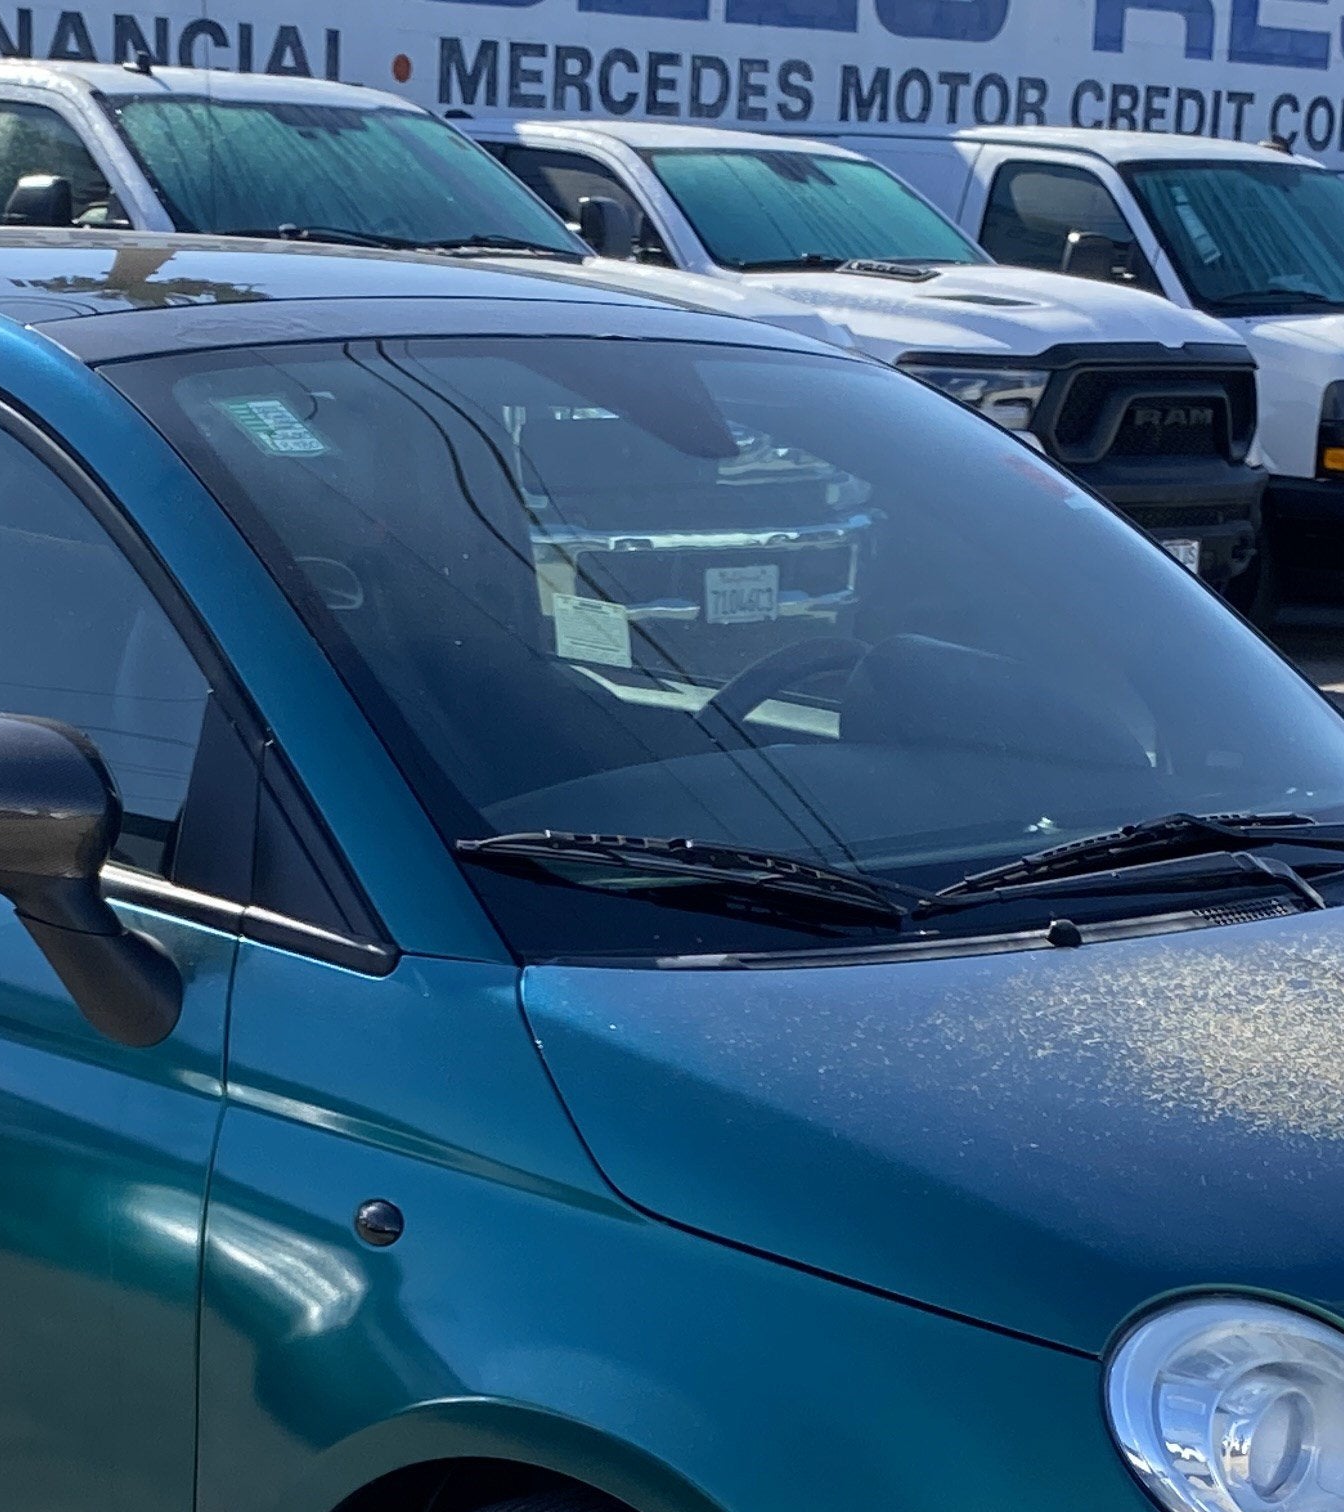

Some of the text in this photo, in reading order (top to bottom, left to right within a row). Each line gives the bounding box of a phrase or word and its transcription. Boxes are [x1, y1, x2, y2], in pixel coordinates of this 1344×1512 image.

[438, 37, 813, 121] MERCEDES
[839, 64, 1048, 126] MOTOR
[1070, 79, 1255, 141] CREDIT
[1134, 407, 1214, 426] RAM
